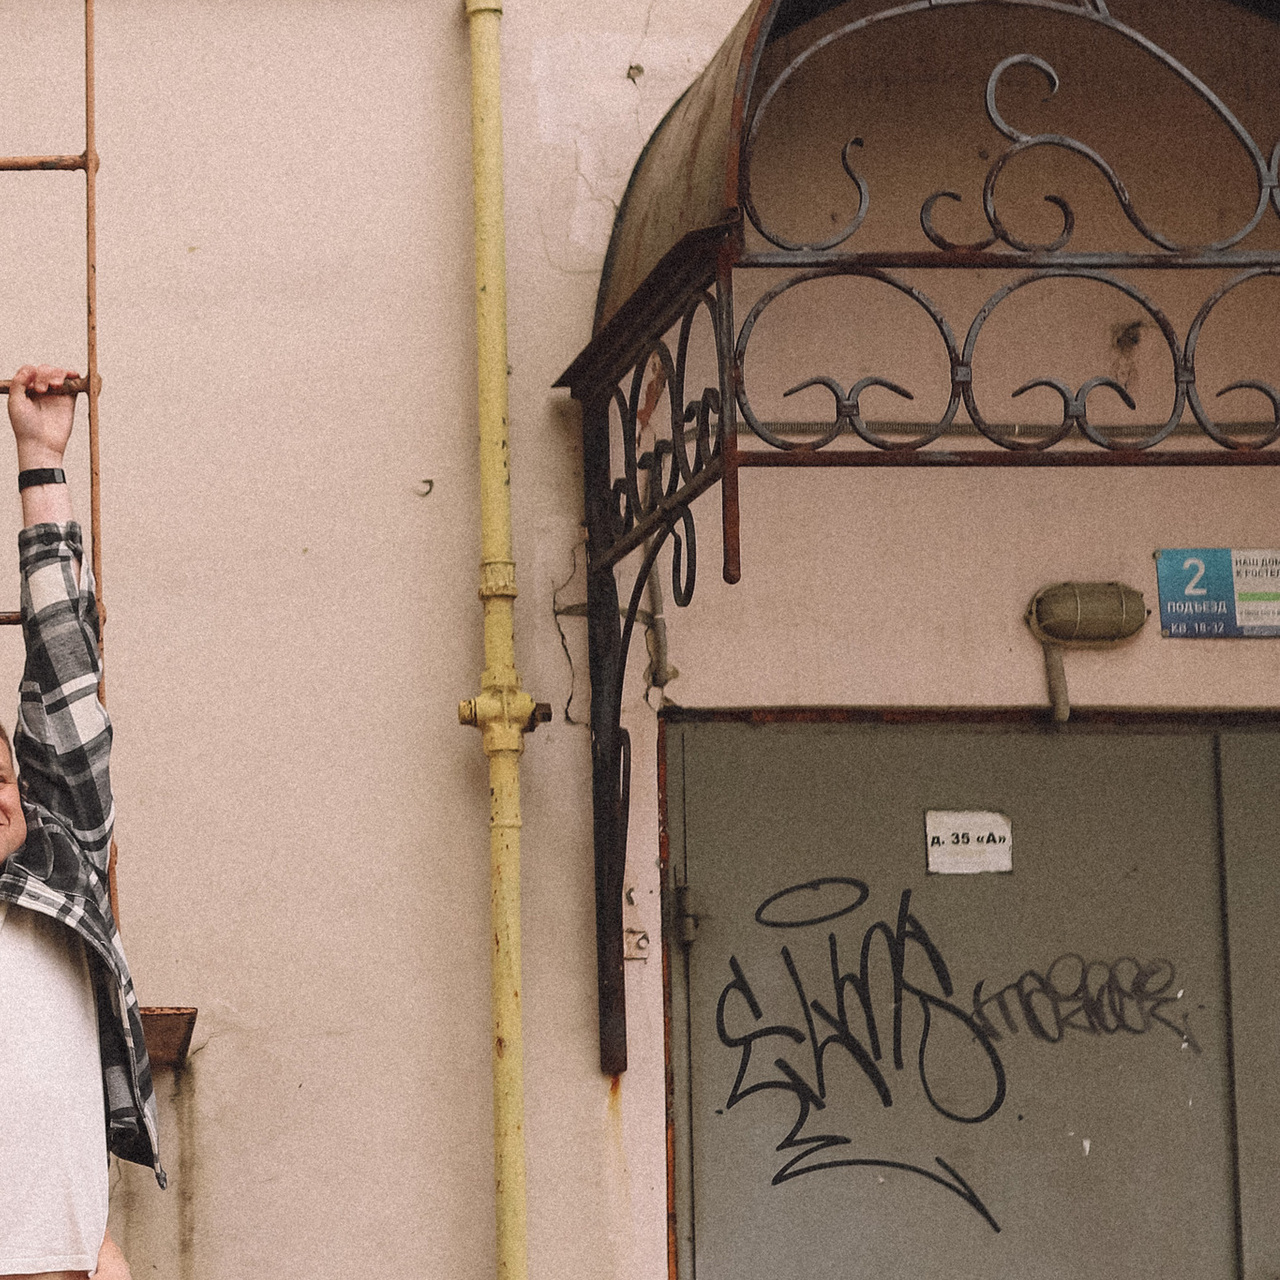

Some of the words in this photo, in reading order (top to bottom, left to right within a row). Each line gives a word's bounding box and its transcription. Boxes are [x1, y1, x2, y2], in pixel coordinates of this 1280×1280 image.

[1235, 558, 1258, 567] НАШ
[1183, 558, 1207, 596] 2
[1167, 601, 1227, 614] ПОДЪЕЗД
[930, 835, 945, 847] д.
[951, 832, 970, 845] 35
